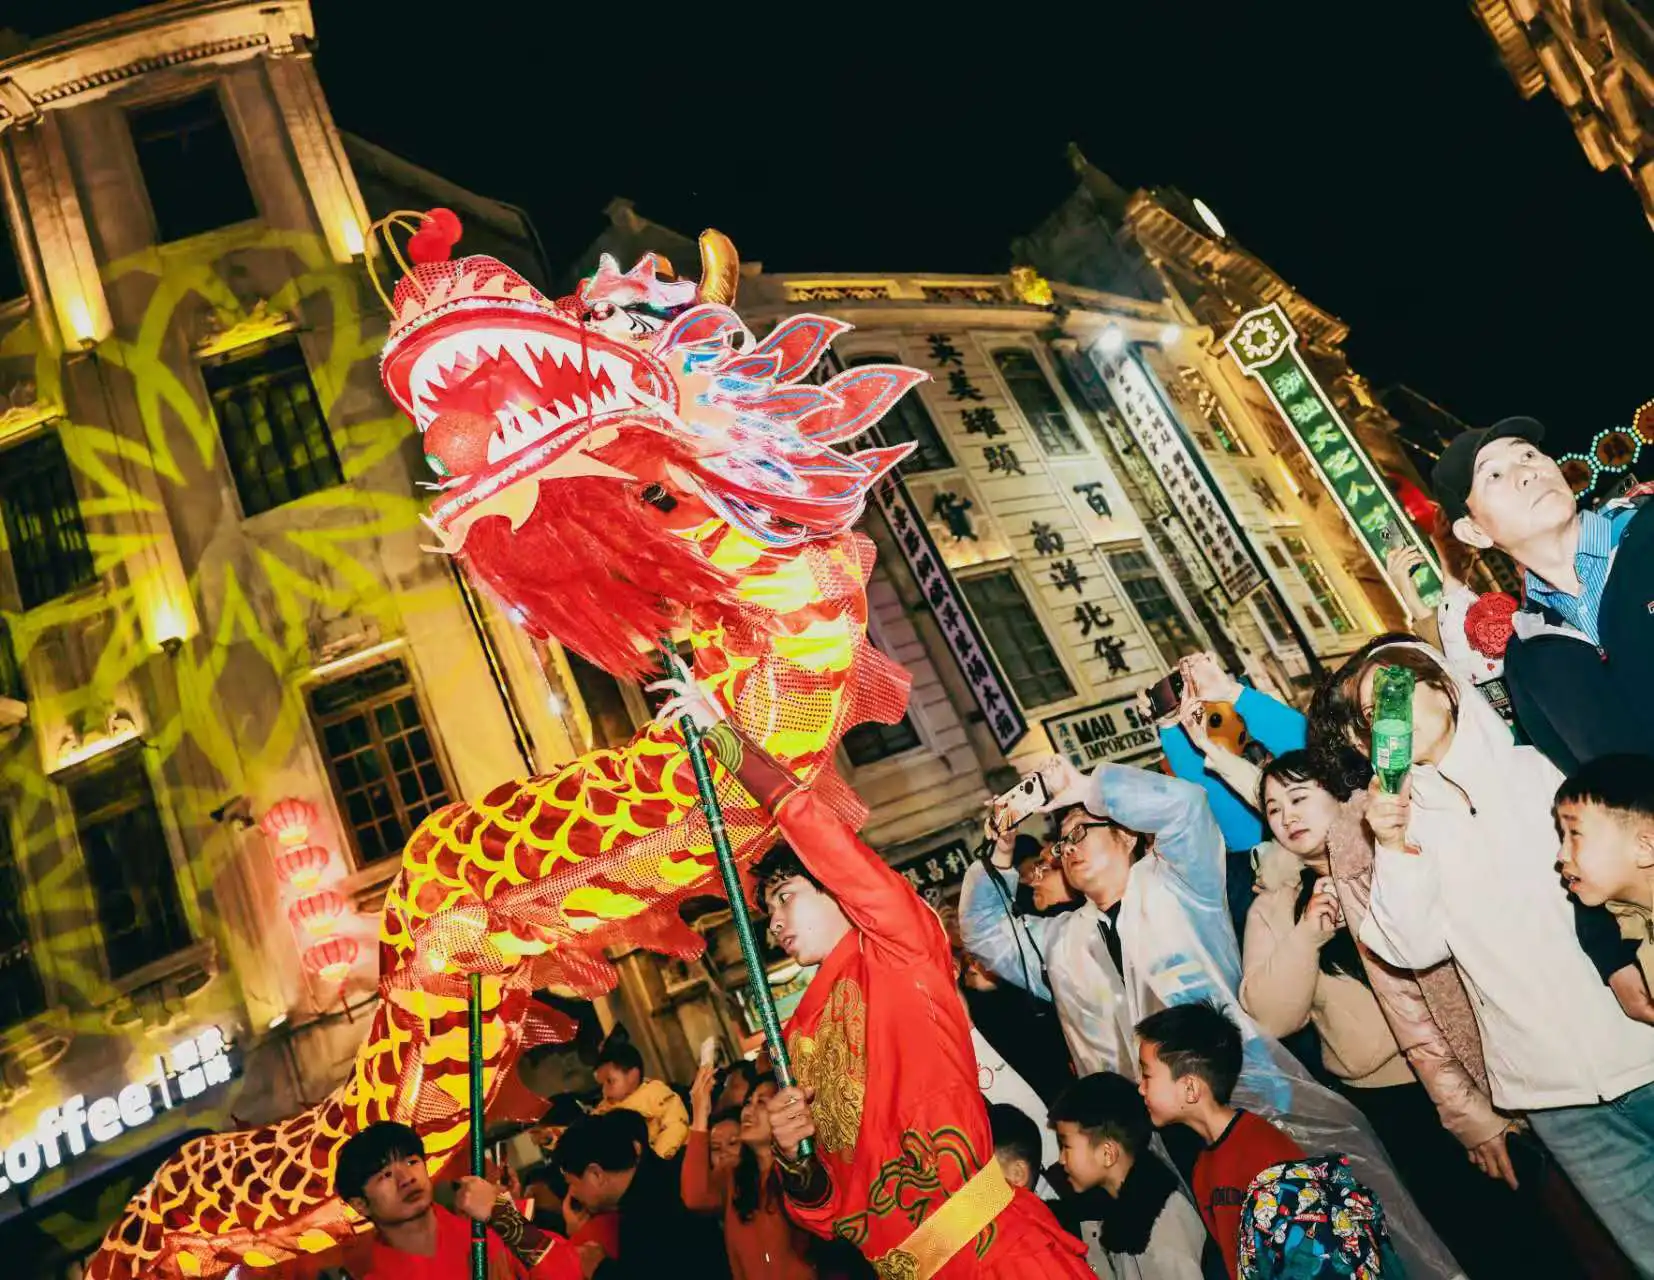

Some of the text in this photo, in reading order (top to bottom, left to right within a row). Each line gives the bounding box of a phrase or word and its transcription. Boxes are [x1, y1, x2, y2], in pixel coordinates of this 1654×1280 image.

[1073, 481, 1112, 521] 百
[1029, 520, 1131, 674] 南洋北貨
[1072, 713, 1117, 744] MAU
[1084, 727, 1155, 760] IMPORTERS
[0, 1081, 153, 1193] offee
